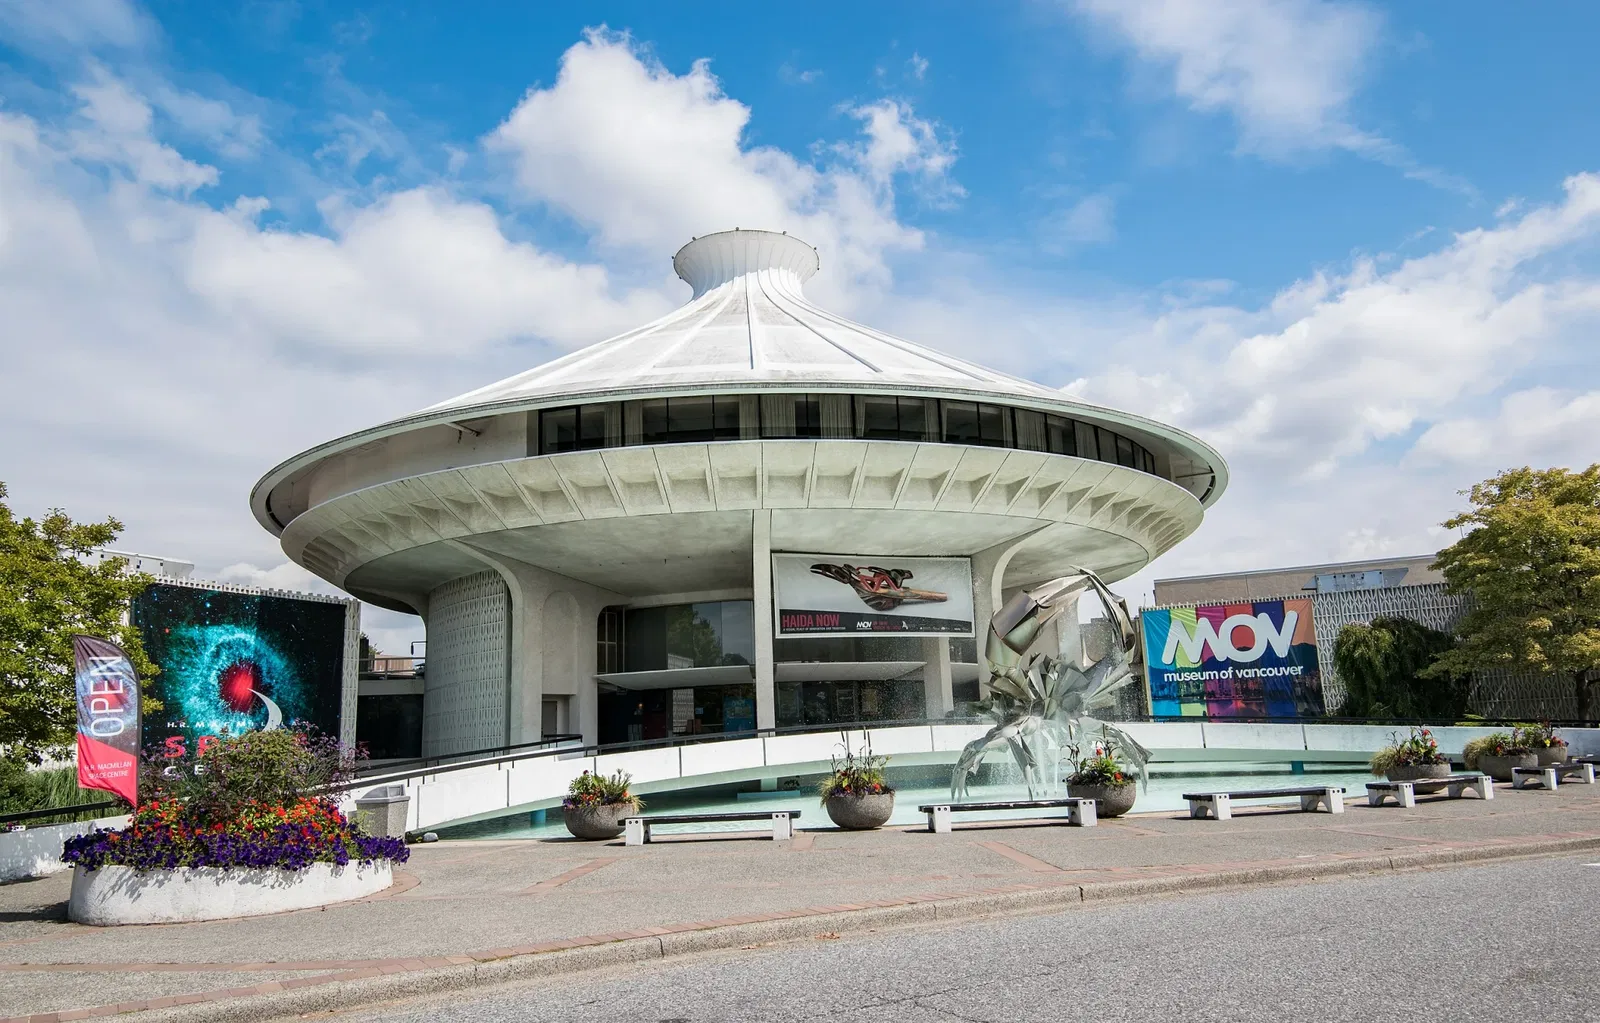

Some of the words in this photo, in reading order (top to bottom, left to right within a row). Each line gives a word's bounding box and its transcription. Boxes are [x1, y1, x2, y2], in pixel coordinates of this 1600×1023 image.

[782, 614, 814, 628] HAIDA
[816, 613, 840, 627] NOW
[1162, 610, 1298, 665] MOV
[1164, 670, 1220, 683] museum
[1220, 666, 1234, 680] of
[1235, 665, 1304, 679] vancouver
[89, 656, 124, 737] OPEN
[97, 762, 132, 770] MACMILLAN
[107, 770, 128, 778] CENTRE
